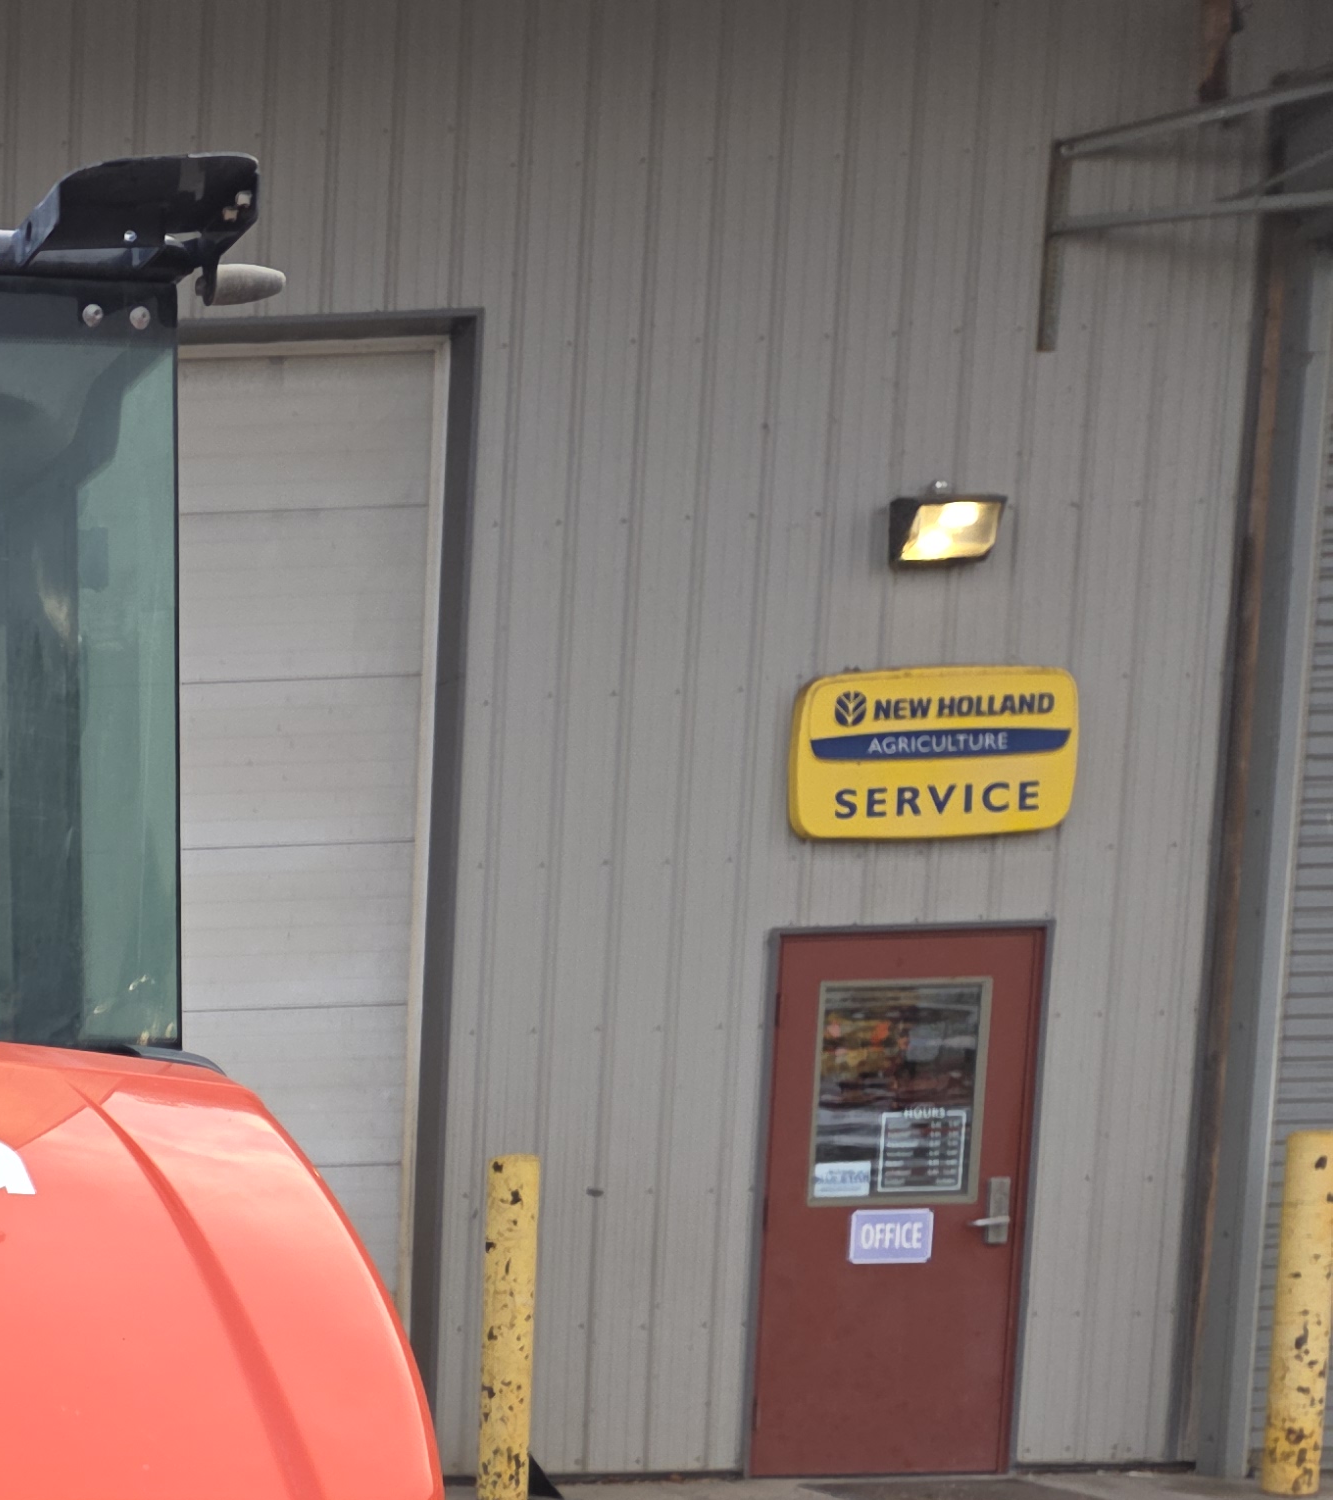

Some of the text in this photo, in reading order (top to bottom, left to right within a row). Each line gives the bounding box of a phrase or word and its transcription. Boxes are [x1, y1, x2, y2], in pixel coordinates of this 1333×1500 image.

[873, 691, 1055, 721] NEW HOLLAND
[866, 731, 1008, 754] AGRICULTURE
[833, 780, 1041, 819] SERVICE
[903, 1106, 946, 1120] HOURS
[860, 1221, 922, 1250] OFFICE
